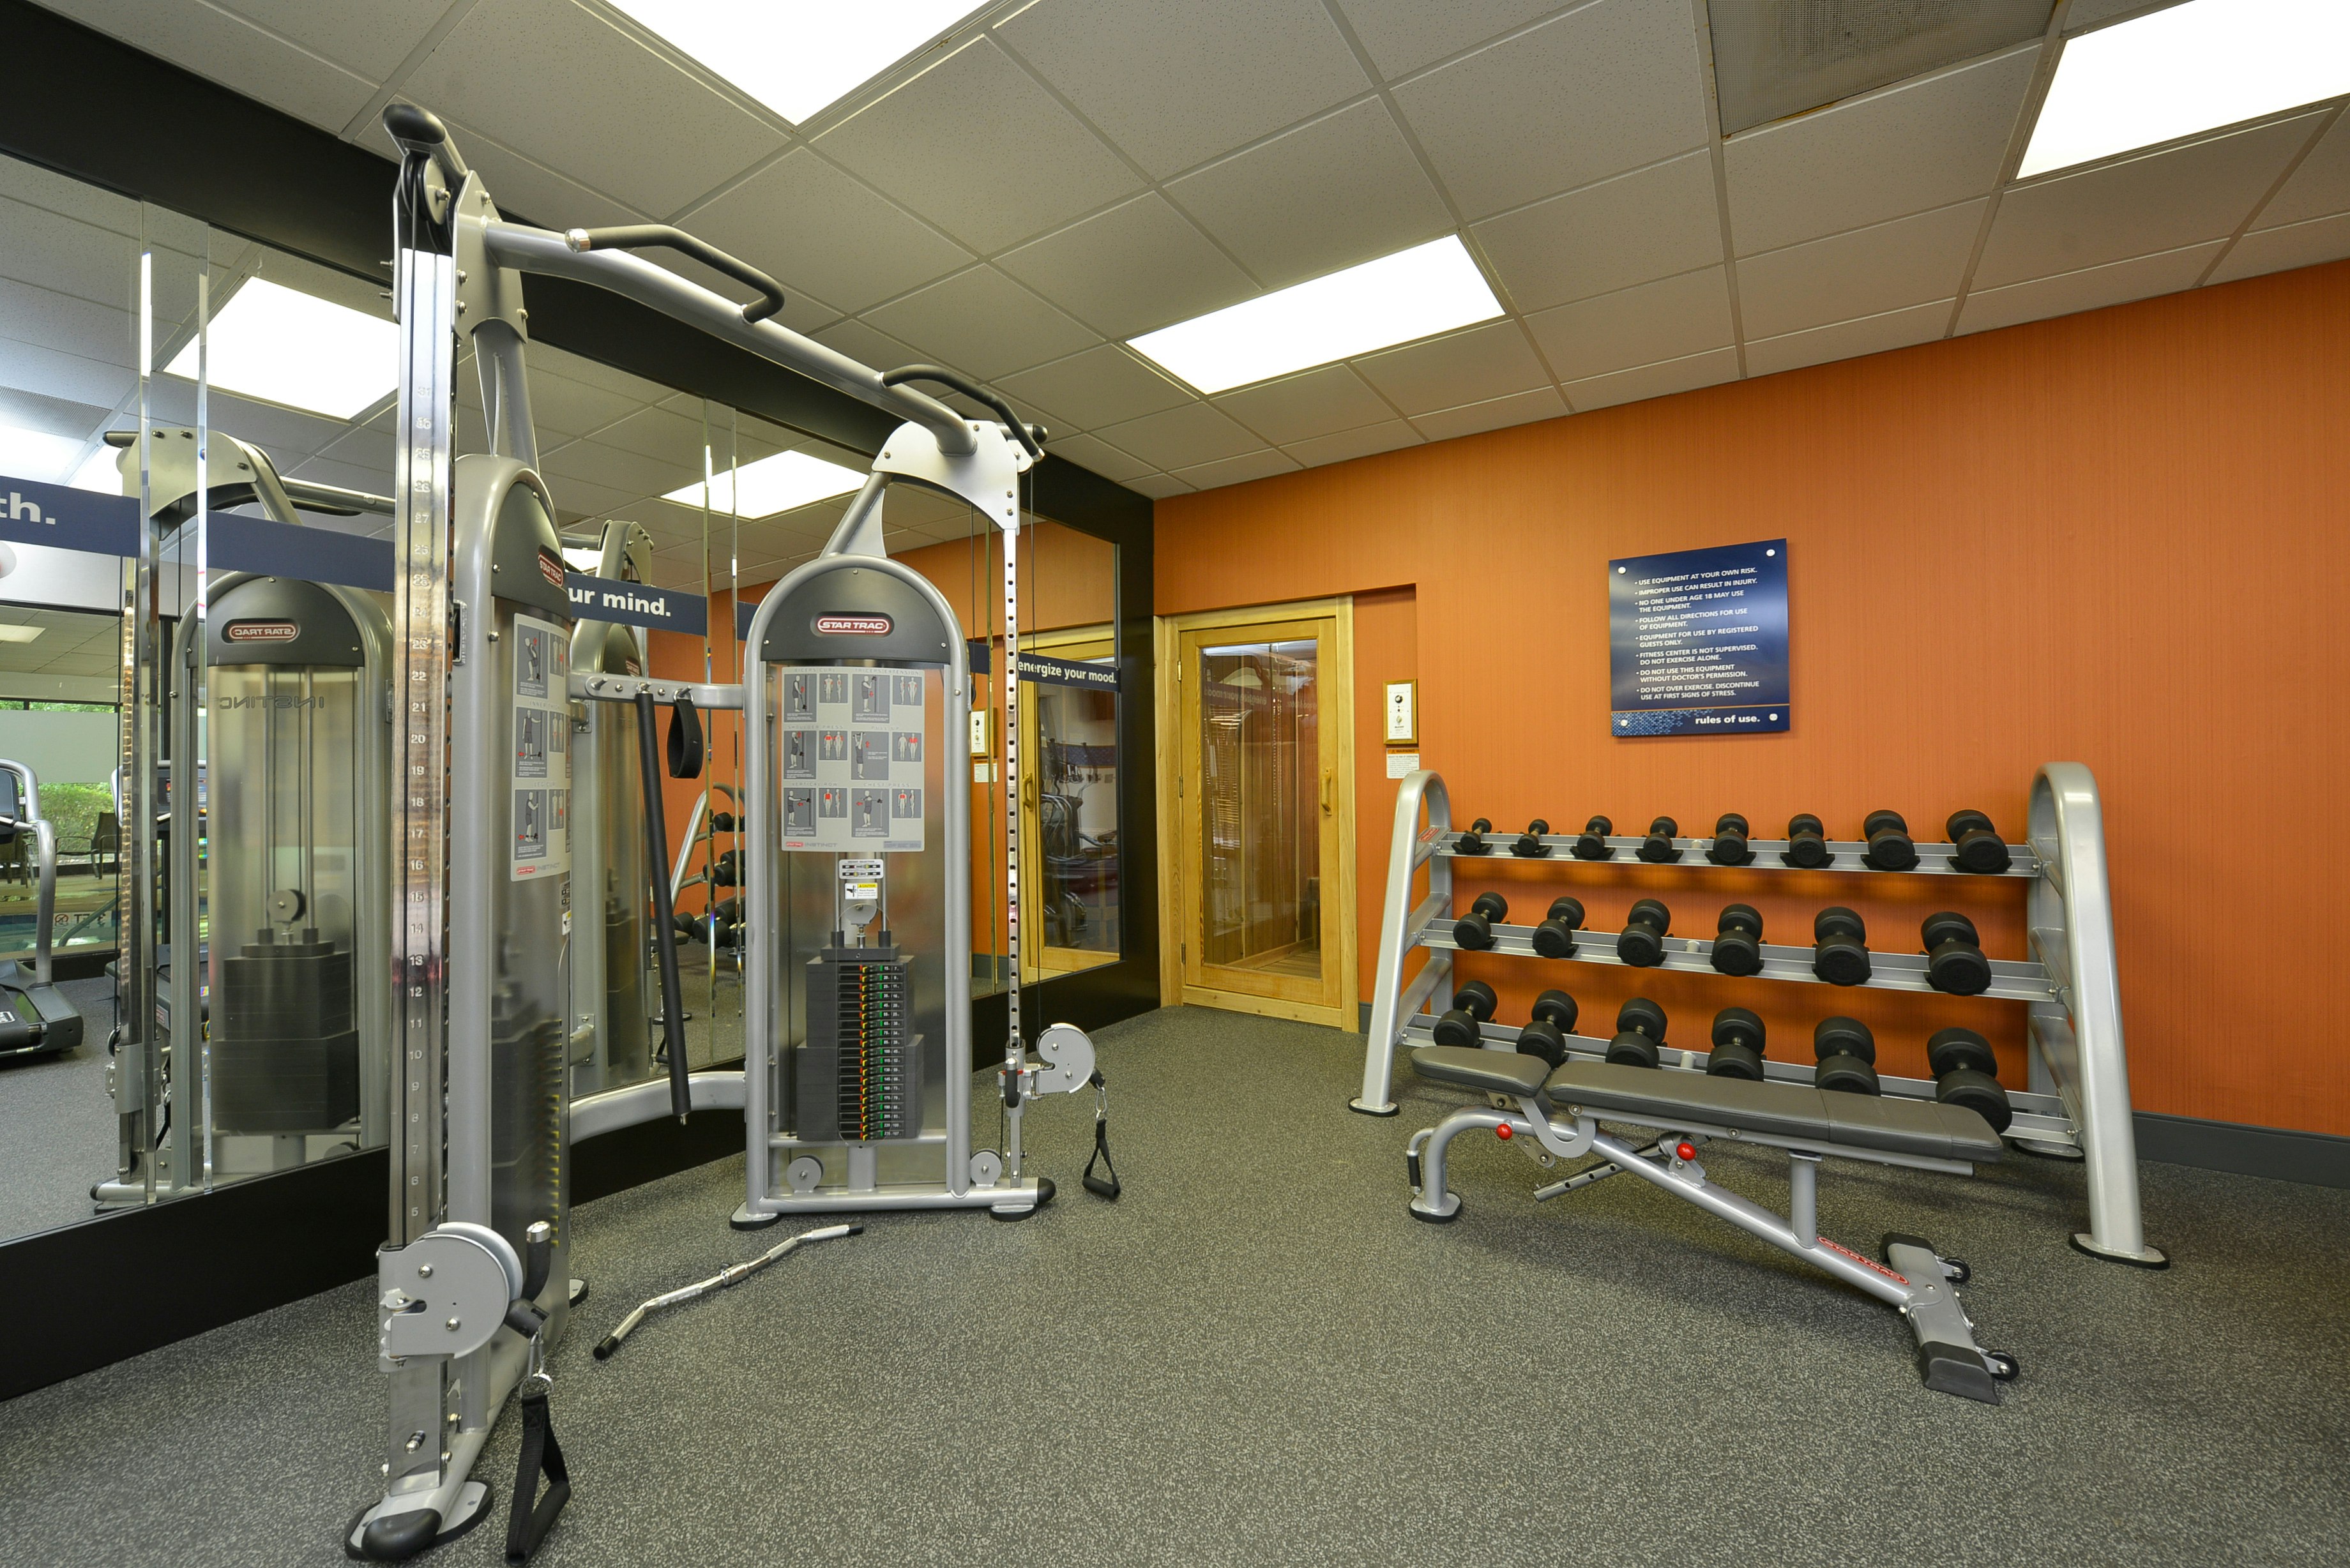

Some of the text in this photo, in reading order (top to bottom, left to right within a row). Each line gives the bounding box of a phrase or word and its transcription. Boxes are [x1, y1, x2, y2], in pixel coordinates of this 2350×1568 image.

[415, 514, 428, 524] 27
[540, 560, 562, 582] STAR TRAC
[1651, 574, 1690, 584] EQUIPMENT
[1699, 570, 1720, 578] YOUR
[1720, 568, 1740, 577] OWN
[1638, 587, 1671, 595] IMPROPER
[1699, 581, 1723, 589] RESULT
[1732, 577, 1757, 585] INJURY.
[568, 587, 671, 617] ur mind.
[1665, 595, 1688, 603] UNDER
[1652, 602, 1691, 612] EQUIPMENT.
[1679, 610, 1718, 619] DIRECTIONS
[1649, 621, 1688, 629] EQUIPMENT.
[1639, 632, 1677, 640] EQUIPMENT
[1717, 625, 1758, 634] REGISTERED
[1715, 644, 1758, 652] SUPERVISED.
[1018, 661, 1117, 684] energize your mood.
[1695, 663, 1735, 672] EQUIPMENT
[412, 670, 427, 681] 22
[1706, 670, 1748, 679] PERMISSION.
[1715, 680, 1759, 689] DISCONTINUE
[412, 702, 426, 712] 21
[1695, 715, 1722, 725] rules
[1723, 714, 1736, 723] of
[411, 734, 426, 744] 20
[411, 766, 425, 776] 19
[411, 797, 424, 807] 18
[411, 829, 423, 838] 17
[411, 860, 423, 870] 16
[411, 924, 423, 933] 14
[409, 955, 423, 965] 13
[409, 987, 423, 997] 12
[410, 1019, 422, 1029] 11
[409, 1050, 422, 1060] 10
[412, 1082, 420, 1091] 9
[412, 1113, 419, 1122] 8
[412, 1145, 419, 1154] 7
[411, 1176, 419, 1186] 6
[411, 1207, 419, 1217] 5
